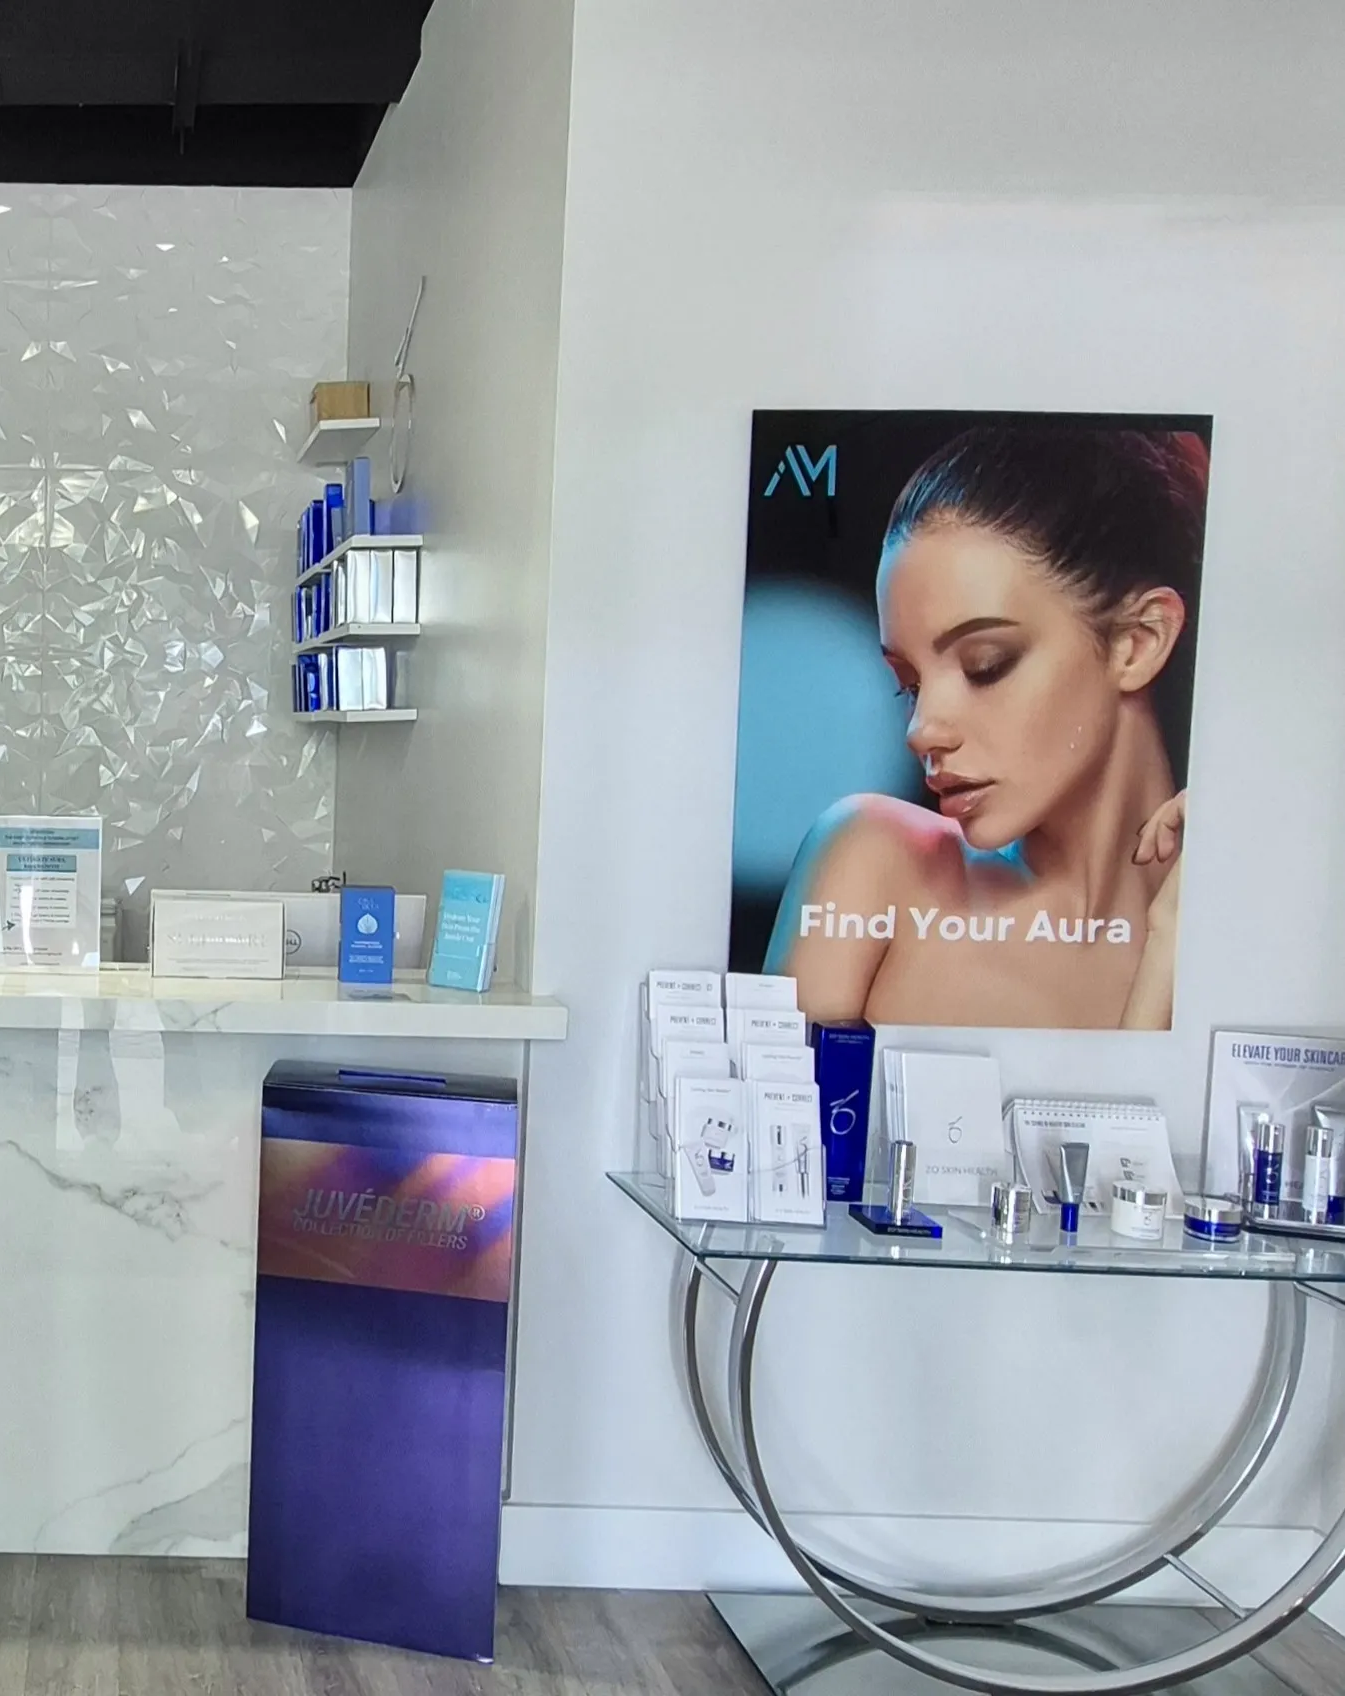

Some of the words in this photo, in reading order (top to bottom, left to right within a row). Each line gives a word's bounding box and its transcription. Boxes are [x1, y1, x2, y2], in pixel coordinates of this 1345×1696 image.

[799, 901, 896, 939] Find
[909, 907, 1016, 941] Your
[1025, 910, 1131, 943] Aura
[1232, 1043, 1271, 1060] ELEVATE
[1274, 1047, 1301, 1062] YOUR
[925, 1165, 940, 1174] ZO
[941, 1166, 961, 1175] SKIN
[963, 1166, 998, 1176] HEALTH
[292, 1217, 382, 1240] COLLECTION
[385, 1228, 404, 1242] OF
[407, 1229, 468, 1250] FILLERS
